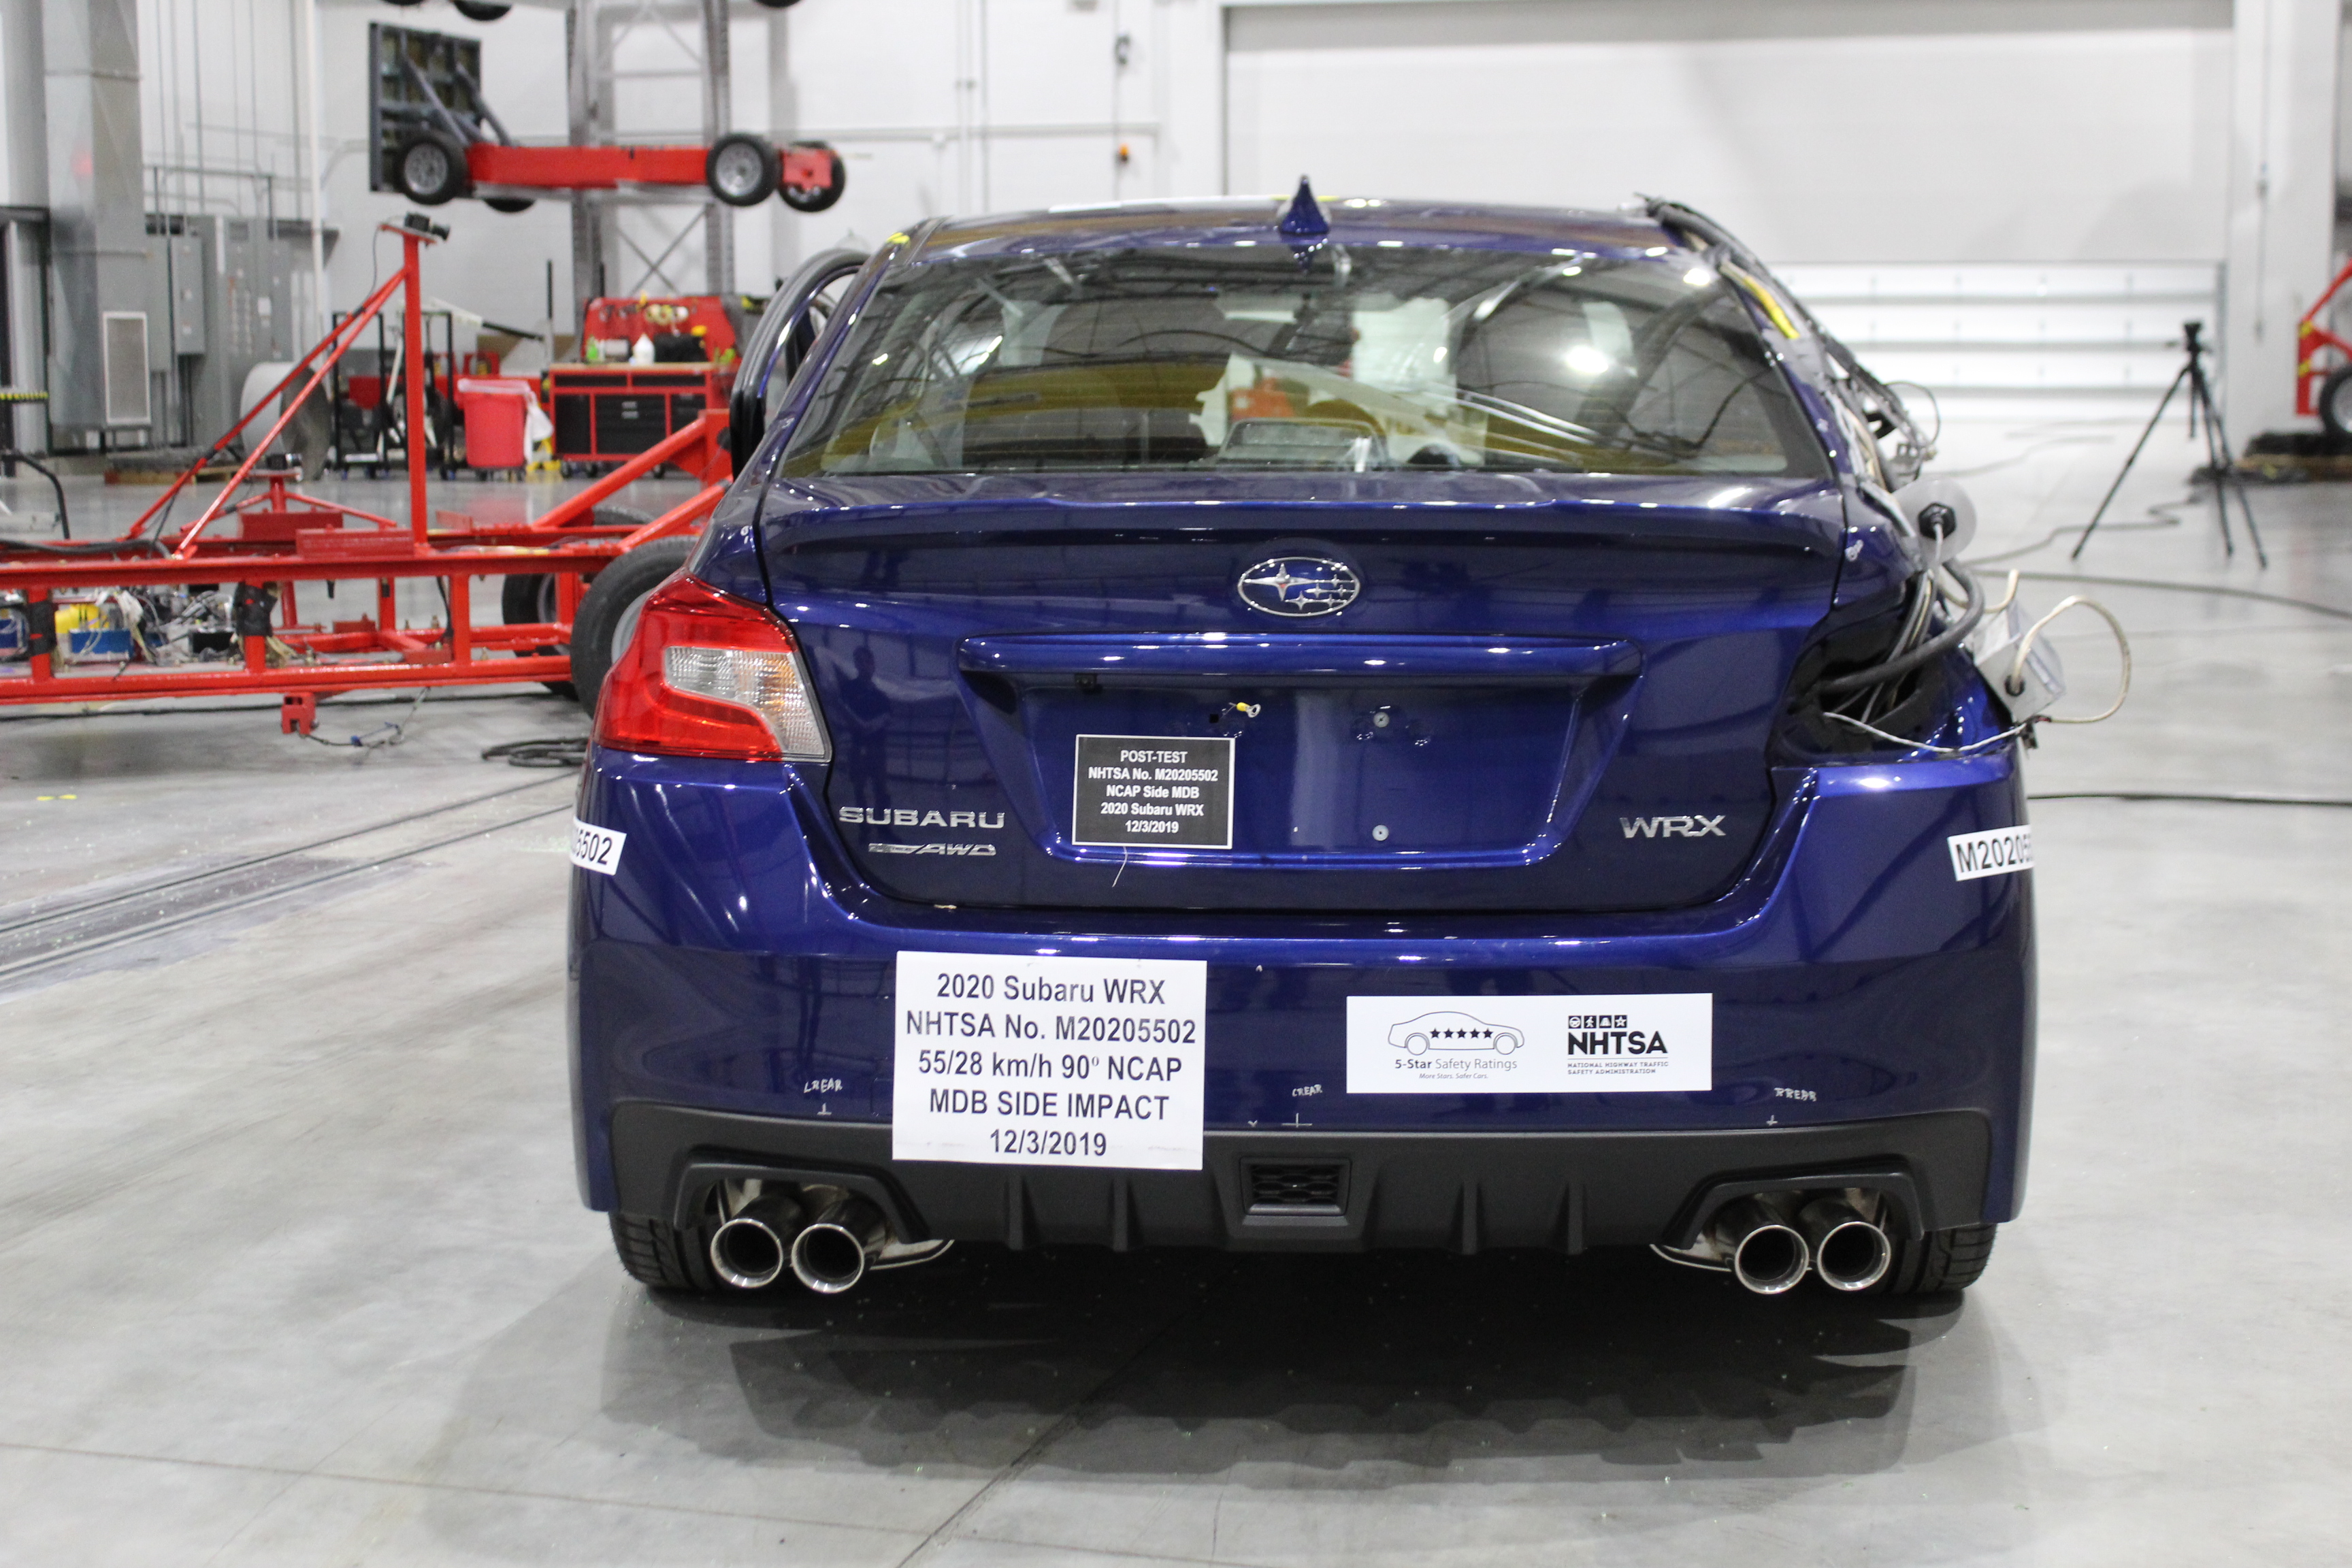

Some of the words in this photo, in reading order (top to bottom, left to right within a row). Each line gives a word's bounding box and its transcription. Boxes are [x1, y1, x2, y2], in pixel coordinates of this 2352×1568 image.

[1120, 749, 1188, 763] POST-TEST
[1088, 766, 1130, 780] NHTSA
[1132, 768, 1152, 780] No.
[1154, 768, 1218, 782] M20205502
[1106, 784, 1141, 798] NCAP
[1143, 785, 1169, 798] Side
[1171, 786, 1200, 798] MDB
[839, 806, 1005, 828] SUBARU
[1100, 802, 1128, 815] 2020
[1130, 802, 1173, 815] Subaru
[1175, 804, 1205, 817] WRX
[1125, 819, 1179, 834] 12/3/2019
[1619, 815, 1727, 838] WRX
[916, 843, 996, 856] AWD
[937, 973, 994, 999] 2020
[1004, 975, 1094, 1003] Subaru
[1103, 978, 1166, 1004] WRX
[906, 1010, 996, 1038] NHTSA
[1005, 1014, 1045, 1040] No.
[1056, 1016, 1196, 1043] M20205502
[1568, 1030, 1668, 1055] NHTSA
[919, 1049, 983, 1076] 55/28
[993, 1052, 1051, 1078] km/h
[1108, 1056, 1182, 1081] NCAP
[1394, 1058, 1432, 1069] 5-Star
[1435, 1058, 1471, 1071] Safety
[1474, 1058, 1518, 1071] Ratings
[930, 1088, 988, 1115] MDB
[998, 1090, 1058, 1117] SIDE
[1068, 1093, 1169, 1120] IMPACT
[990, 1128, 1107, 1156] 12/3/2019
